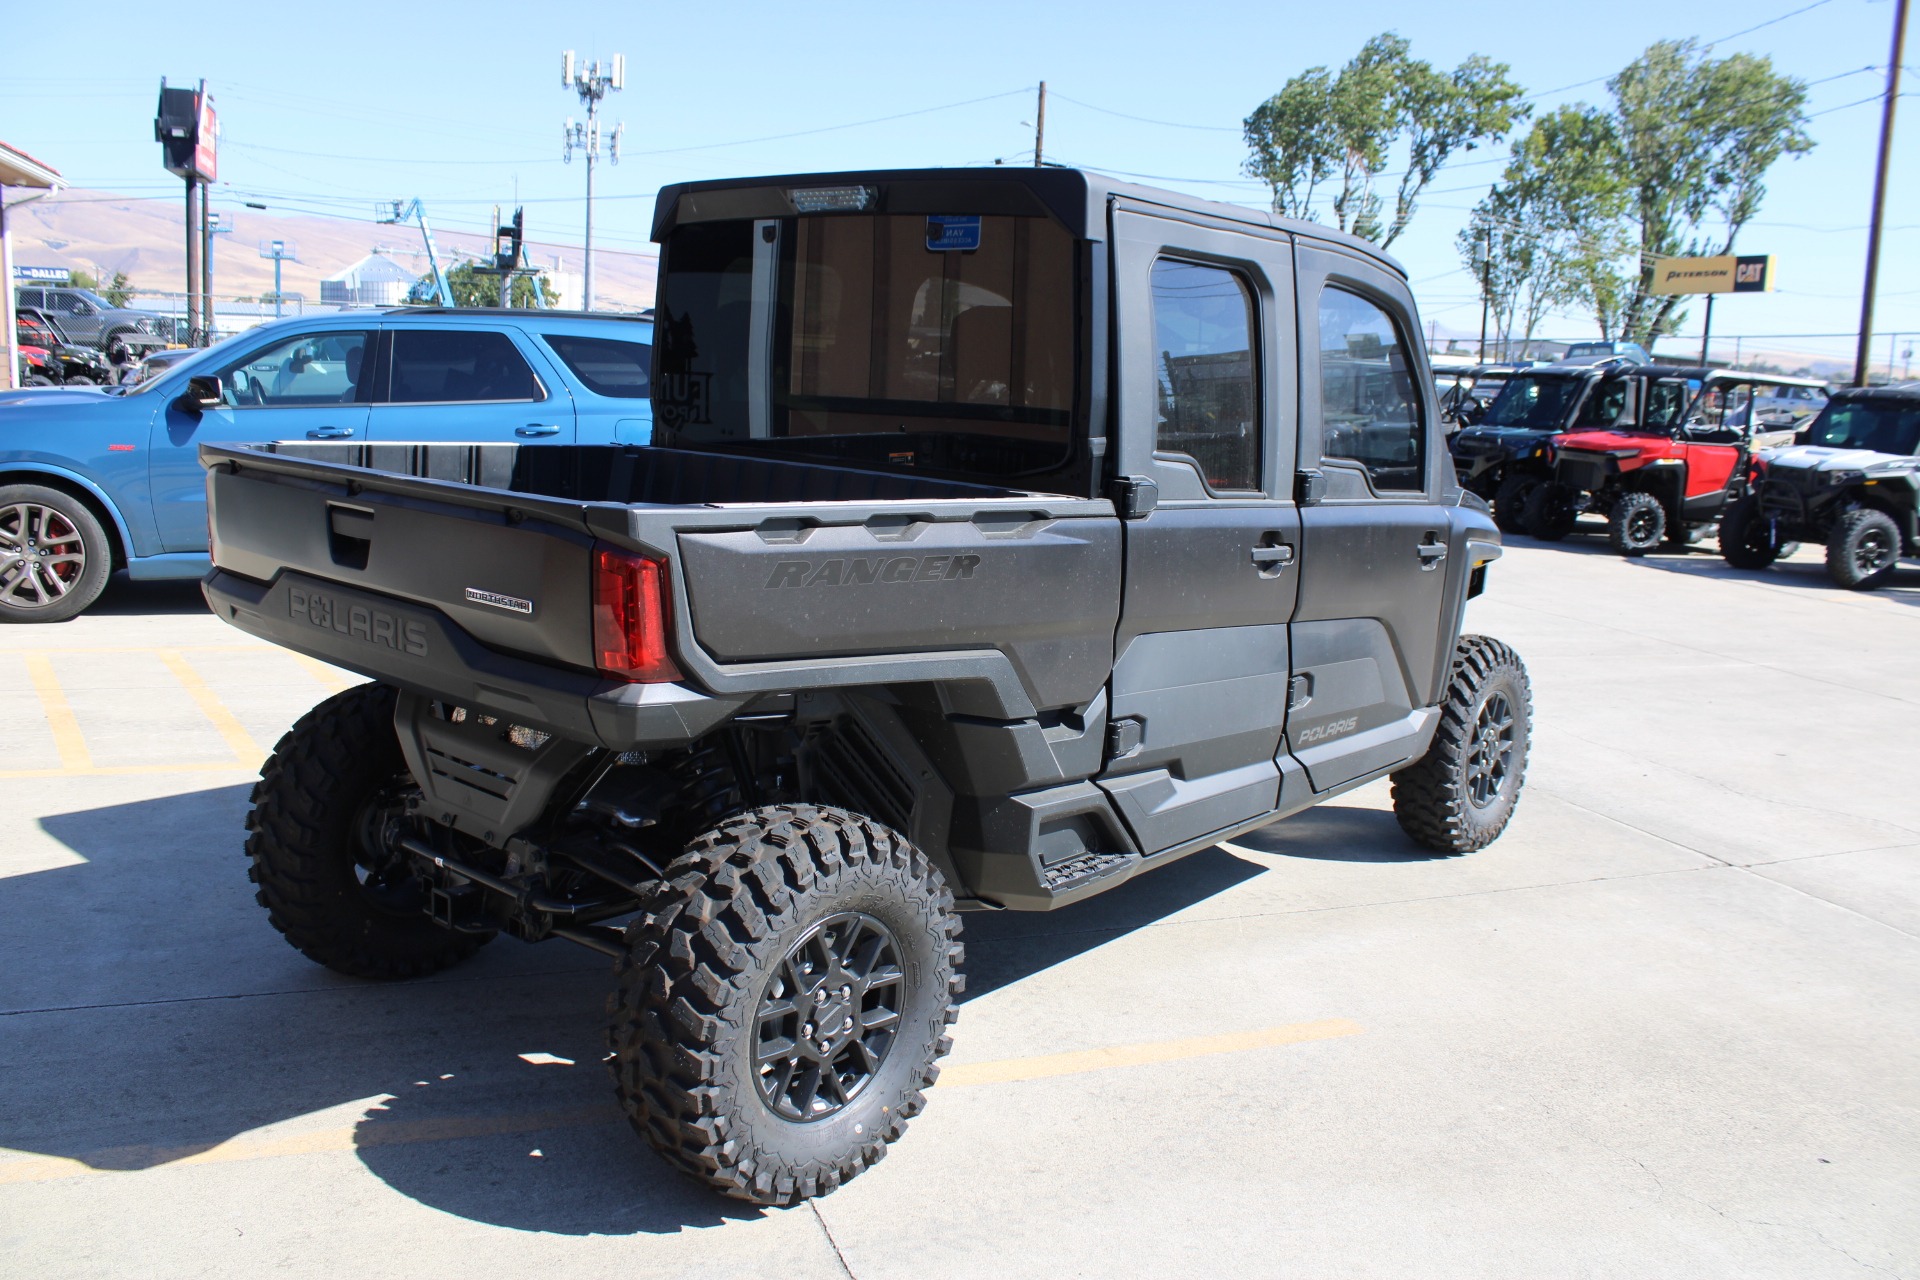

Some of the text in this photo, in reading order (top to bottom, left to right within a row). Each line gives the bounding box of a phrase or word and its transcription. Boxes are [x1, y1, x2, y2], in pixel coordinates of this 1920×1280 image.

[32, 268, 69, 280] DALLES
[1666, 262, 1764, 283] PETERSON CAT
[763, 553, 982, 591] RANGER
[466, 588, 531, 612] NORTHSTAR
[288, 586, 429, 657] POLARIS
[1297, 716, 1358, 745] POLARIS
